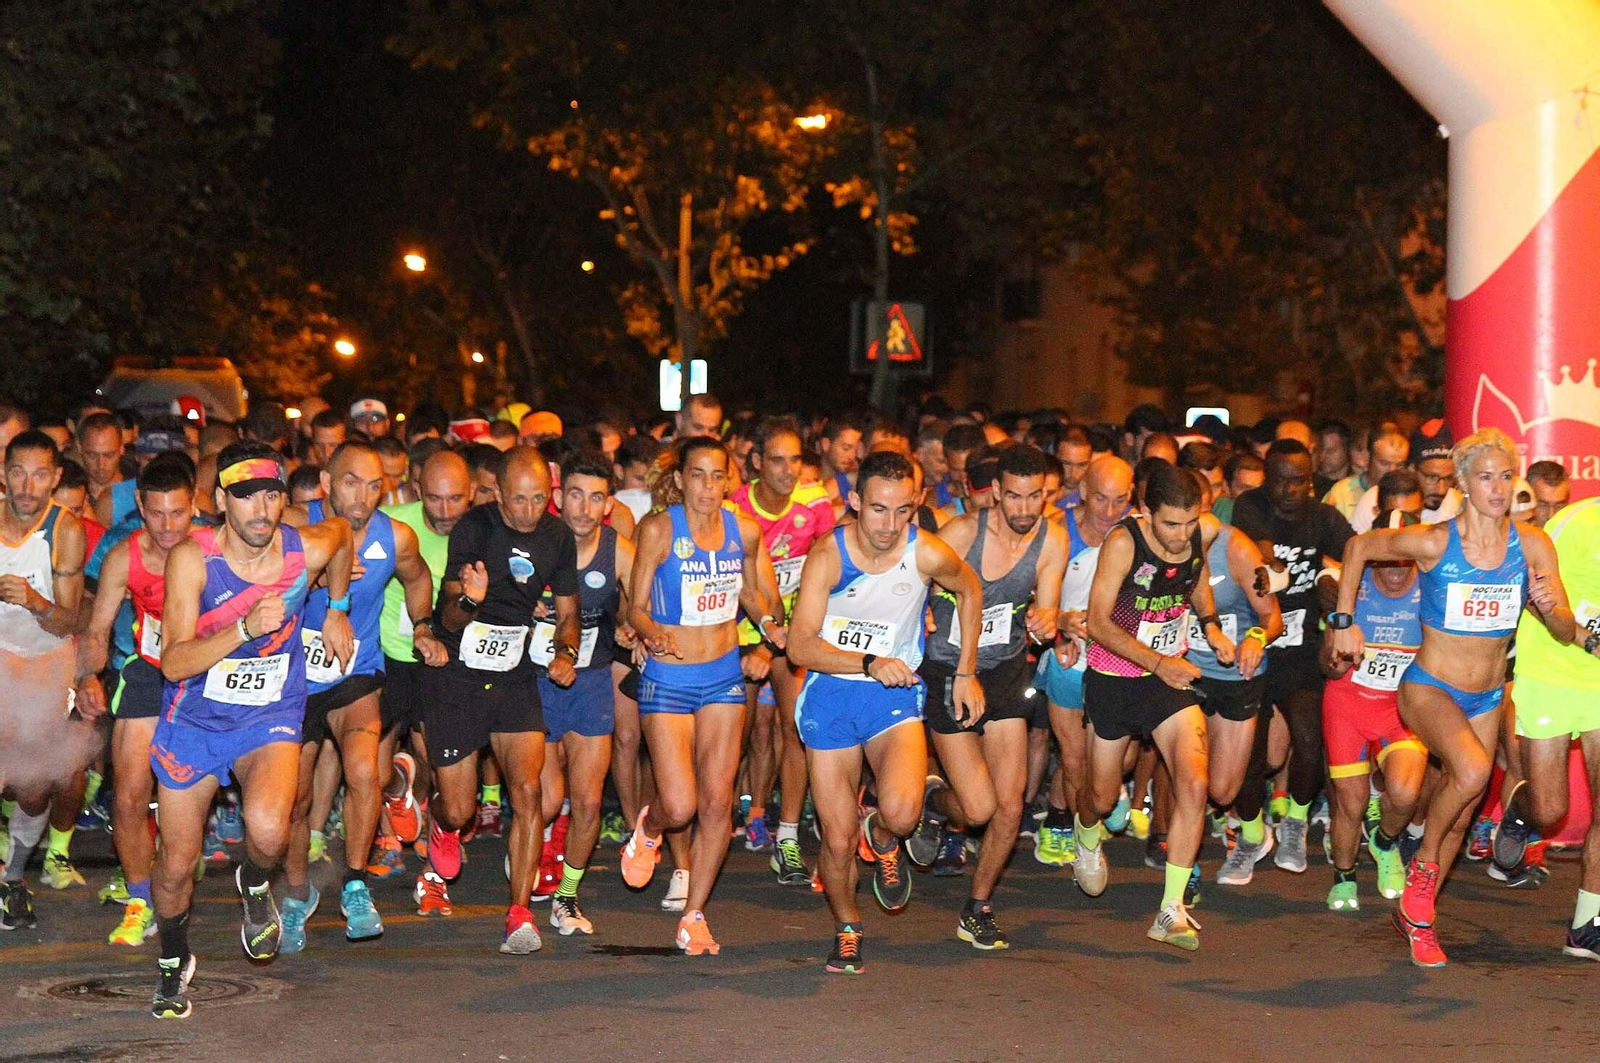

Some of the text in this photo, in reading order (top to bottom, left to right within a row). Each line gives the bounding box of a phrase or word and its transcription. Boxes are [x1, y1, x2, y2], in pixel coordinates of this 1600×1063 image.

[680, 558, 742, 572] ANA DIAS
[1472, 586, 1513, 594] NOCTURNA
[1483, 593, 1511, 601] HUELVA
[697, 592, 727, 612] 803
[1463, 600, 1500, 618] 629
[848, 620, 889, 630] NOCTURNA
[838, 630, 873, 650] 647
[1151, 630, 1177, 650] 613
[1373, 626, 1405, 644] PEREZ
[475, 639, 509, 657] 382
[1367, 661, 1398, 679] 621
[225, 672, 266, 690] 625
